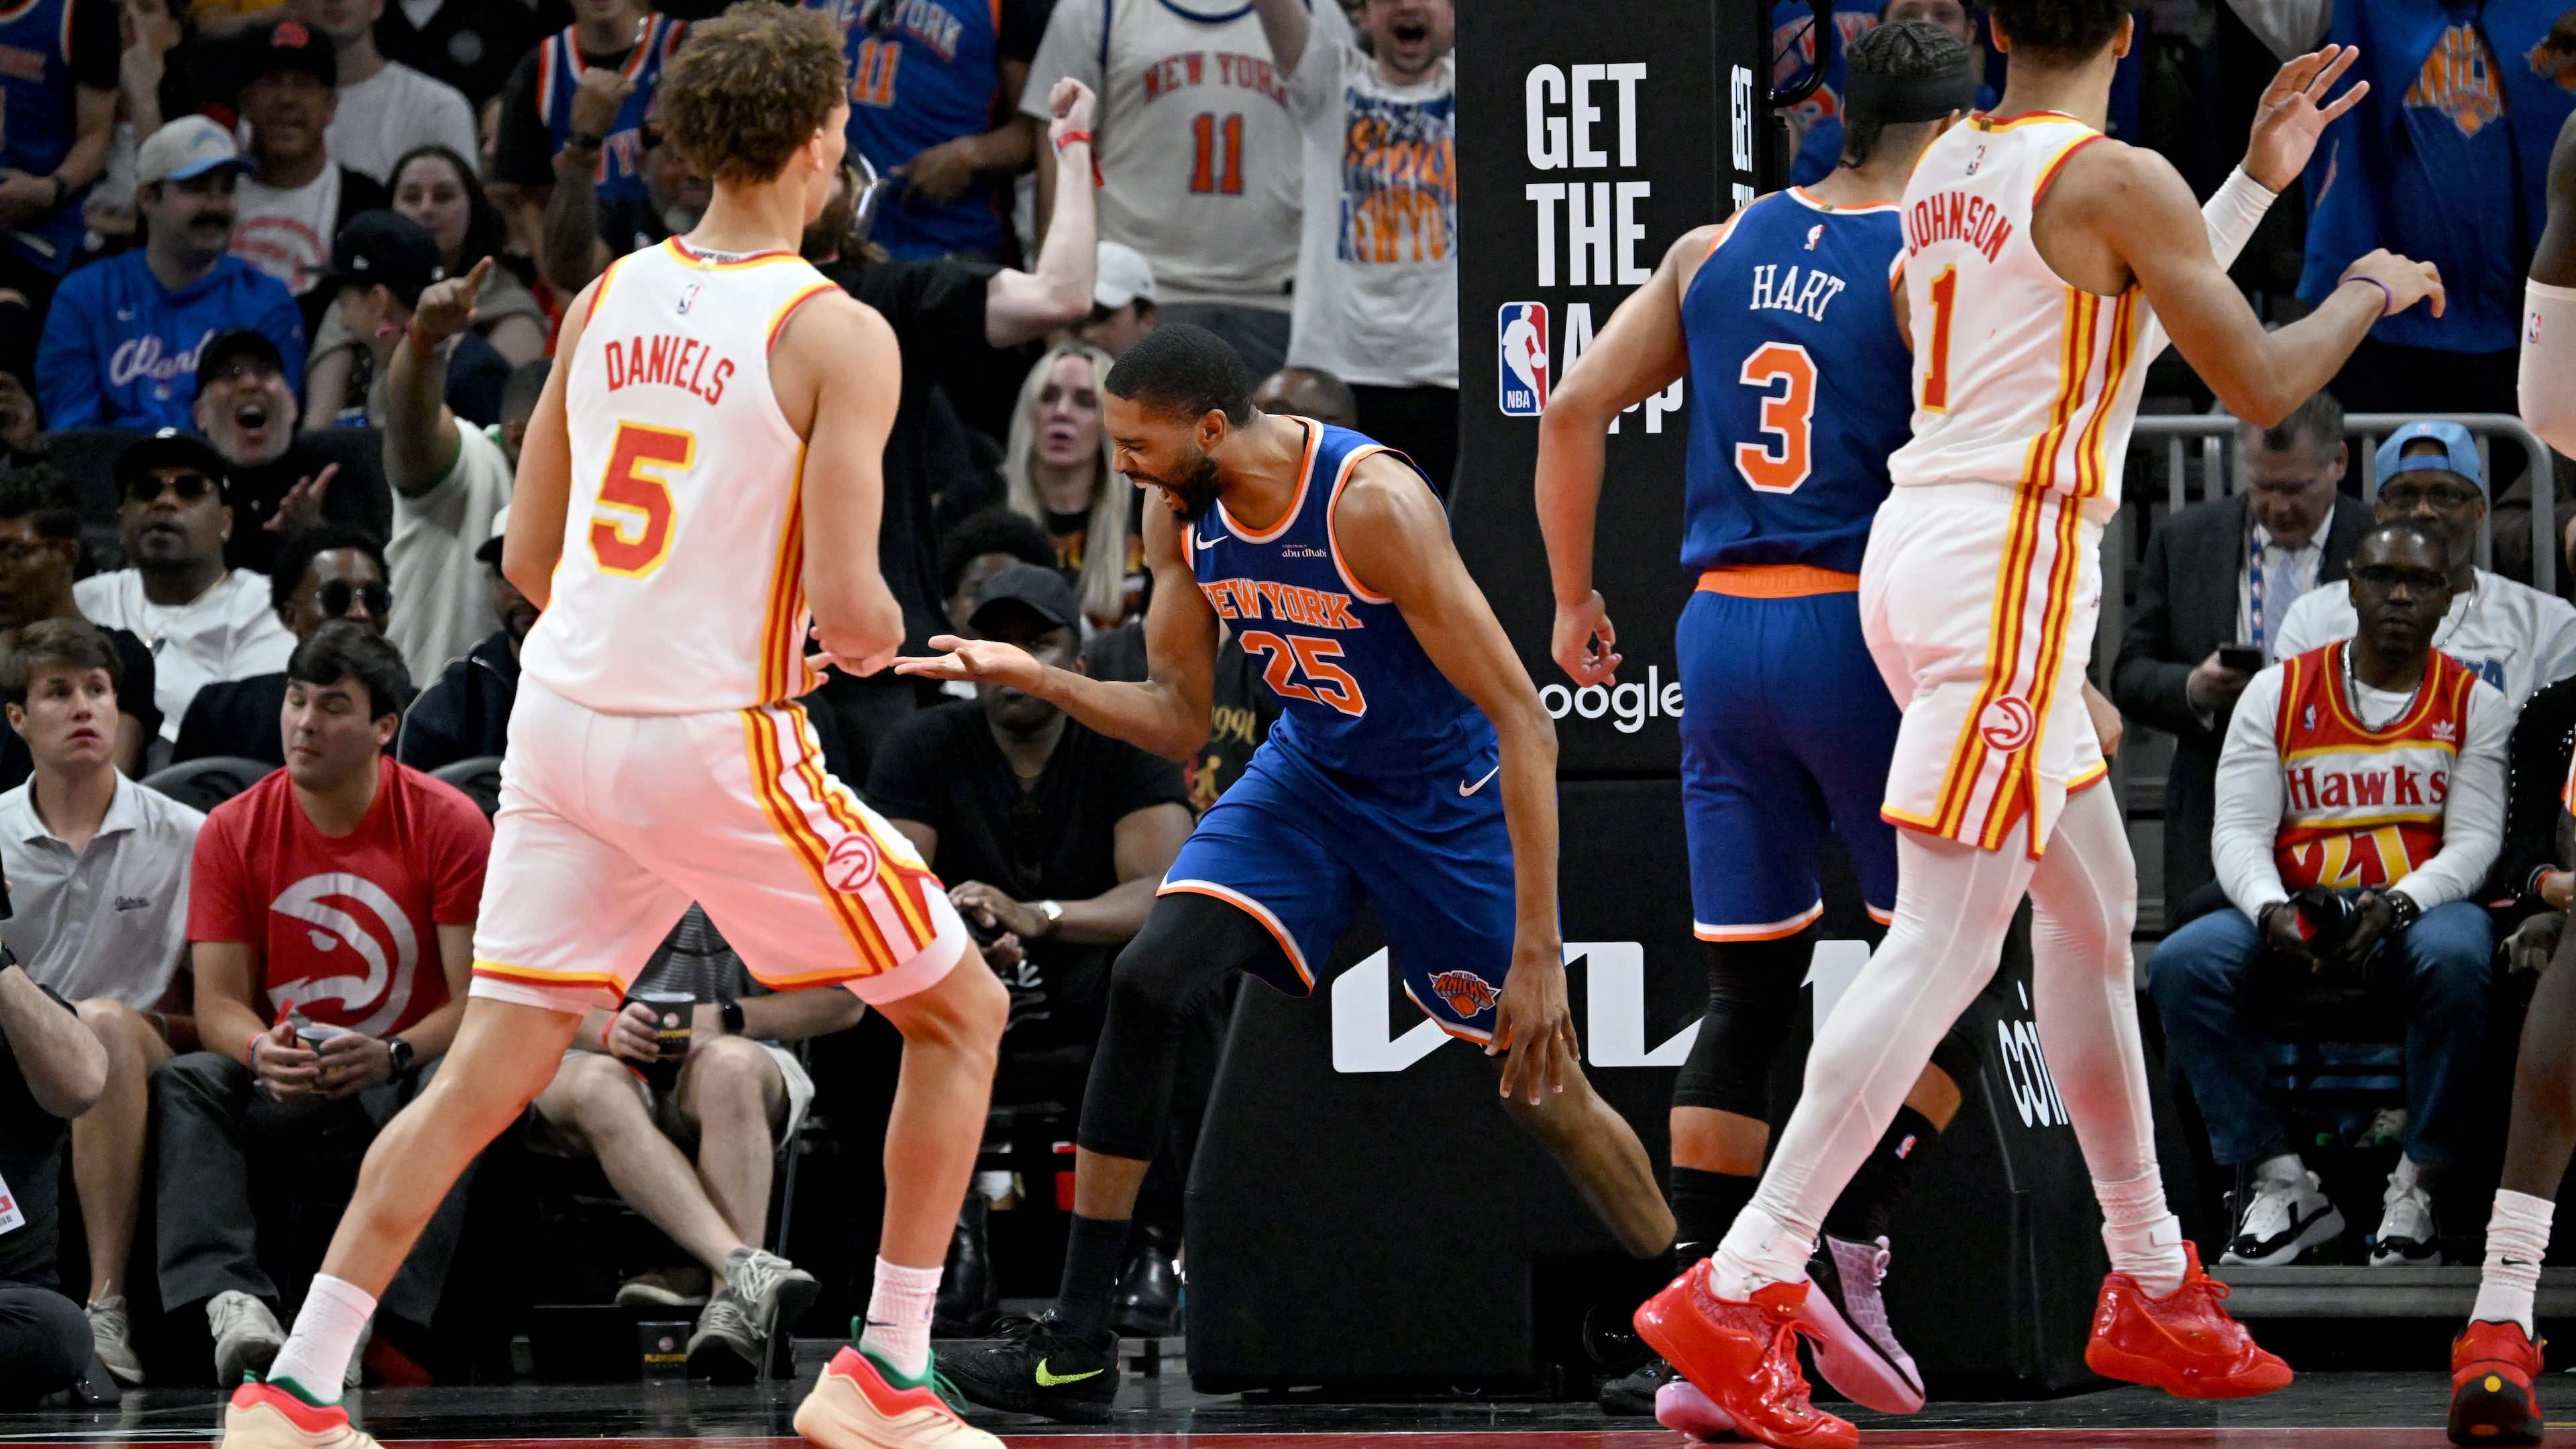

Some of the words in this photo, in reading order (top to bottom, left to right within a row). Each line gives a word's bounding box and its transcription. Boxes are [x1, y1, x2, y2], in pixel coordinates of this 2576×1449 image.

[849, 37, 903, 109] 11
[1142, 51, 1205, 105] NEW
[1526, 62, 1647, 170] GET
[1731, 64, 1753, 172] GET
[1188, 111, 1244, 195] 11
[1525, 181, 1652, 286] THE
[1909, 191, 2013, 264] JOHNSON
[1750, 264, 1846, 322] HART
[604, 334, 735, 406] DANIELS
[1921, 263, 1957, 415] 1
[1507, 390, 1531, 409] NBA
[1735, 341, 1818, 495] 3
[588, 419, 694, 580] 5
[1282, 549, 1300, 557] abu
[1301, 548, 1327, 558] dhabi
[1257, 582, 1364, 631] YORK
[1238, 630, 1368, 718] 25
[1540, 665, 1684, 733] oogle
[2286, 764, 2448, 811] Hawks
[2292, 824, 2412, 888] 21
[1434, 975, 1494, 1005] KNICKS
